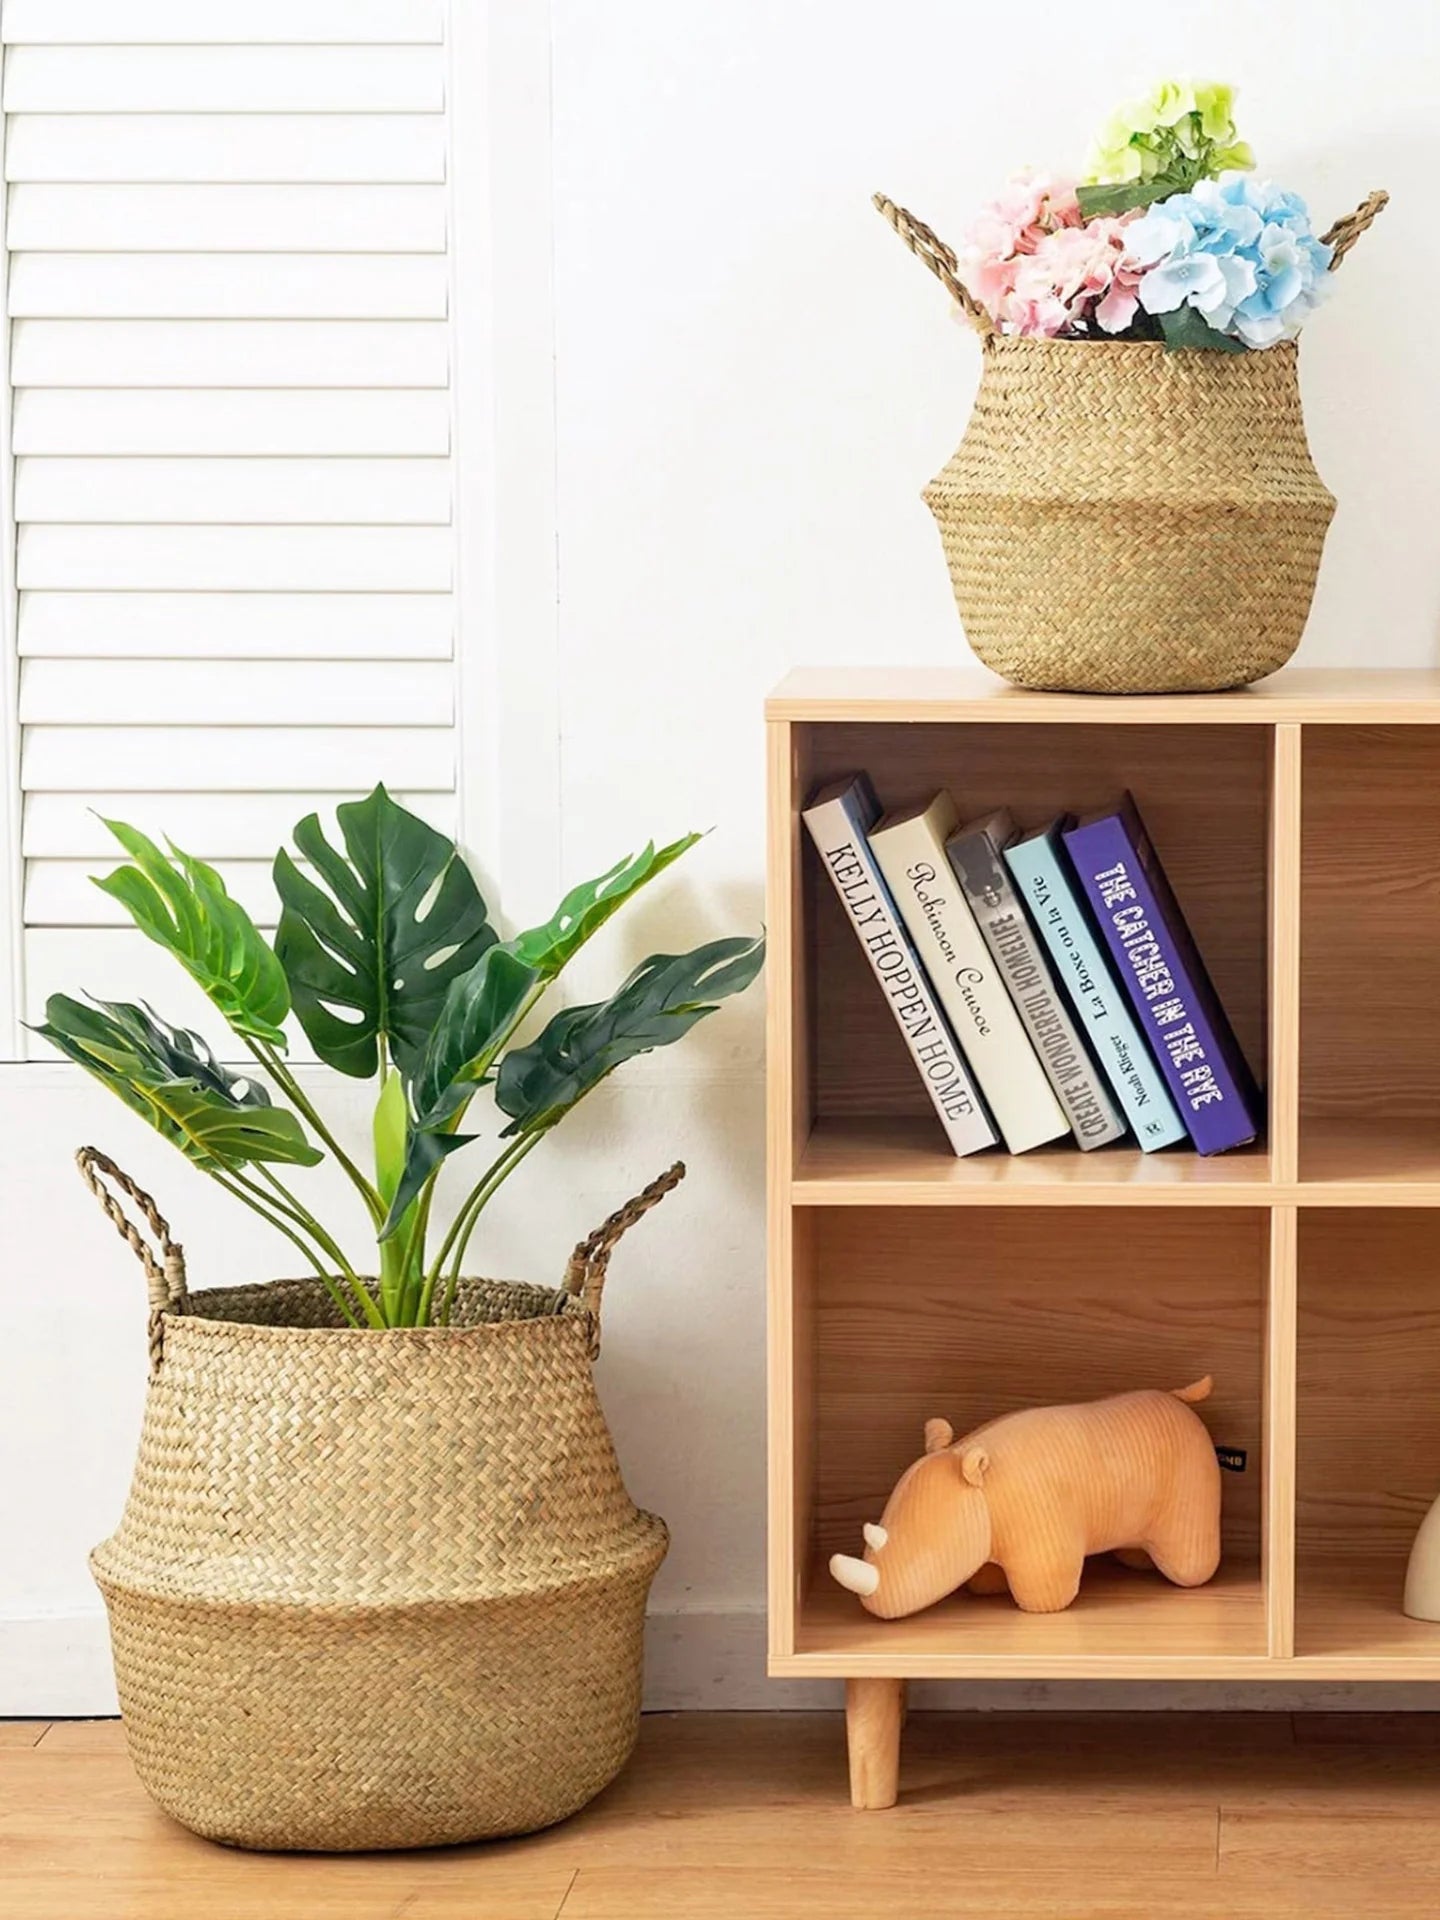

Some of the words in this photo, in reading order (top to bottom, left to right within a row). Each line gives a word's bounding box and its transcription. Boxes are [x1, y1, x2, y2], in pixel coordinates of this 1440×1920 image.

[1033, 875, 1052, 906] Vie
[1094, 862, 1137, 909] THE
[1048, 907, 1063, 925] la
[1057, 926, 1075, 948] ou
[906, 862, 956, 965] Robinson
[955, 967, 991, 1037] Crusoe
[989, 913, 1042, 992] HOMELIFE
[1070, 951, 1096, 994] Boxe
[1112, 905, 1175, 1001] CATCHER
[826, 842, 886, 926] KELLY
[866, 930, 937, 1038] HOPPEN
[917, 1039, 974, 1121] HOME
[1092, 995, 1109, 1020] La
[1150, 997, 1187, 1026] IN
[1023, 988, 1083, 1085] WONDERFUL
[1110, 1034, 1135, 1076] Klieger
[1163, 1022, 1206, 1069] THE
[1063, 1080, 1110, 1139] CREATE
[1127, 1073, 1151, 1108] Noah
[1180, 1064, 1224, 1112] RYE
